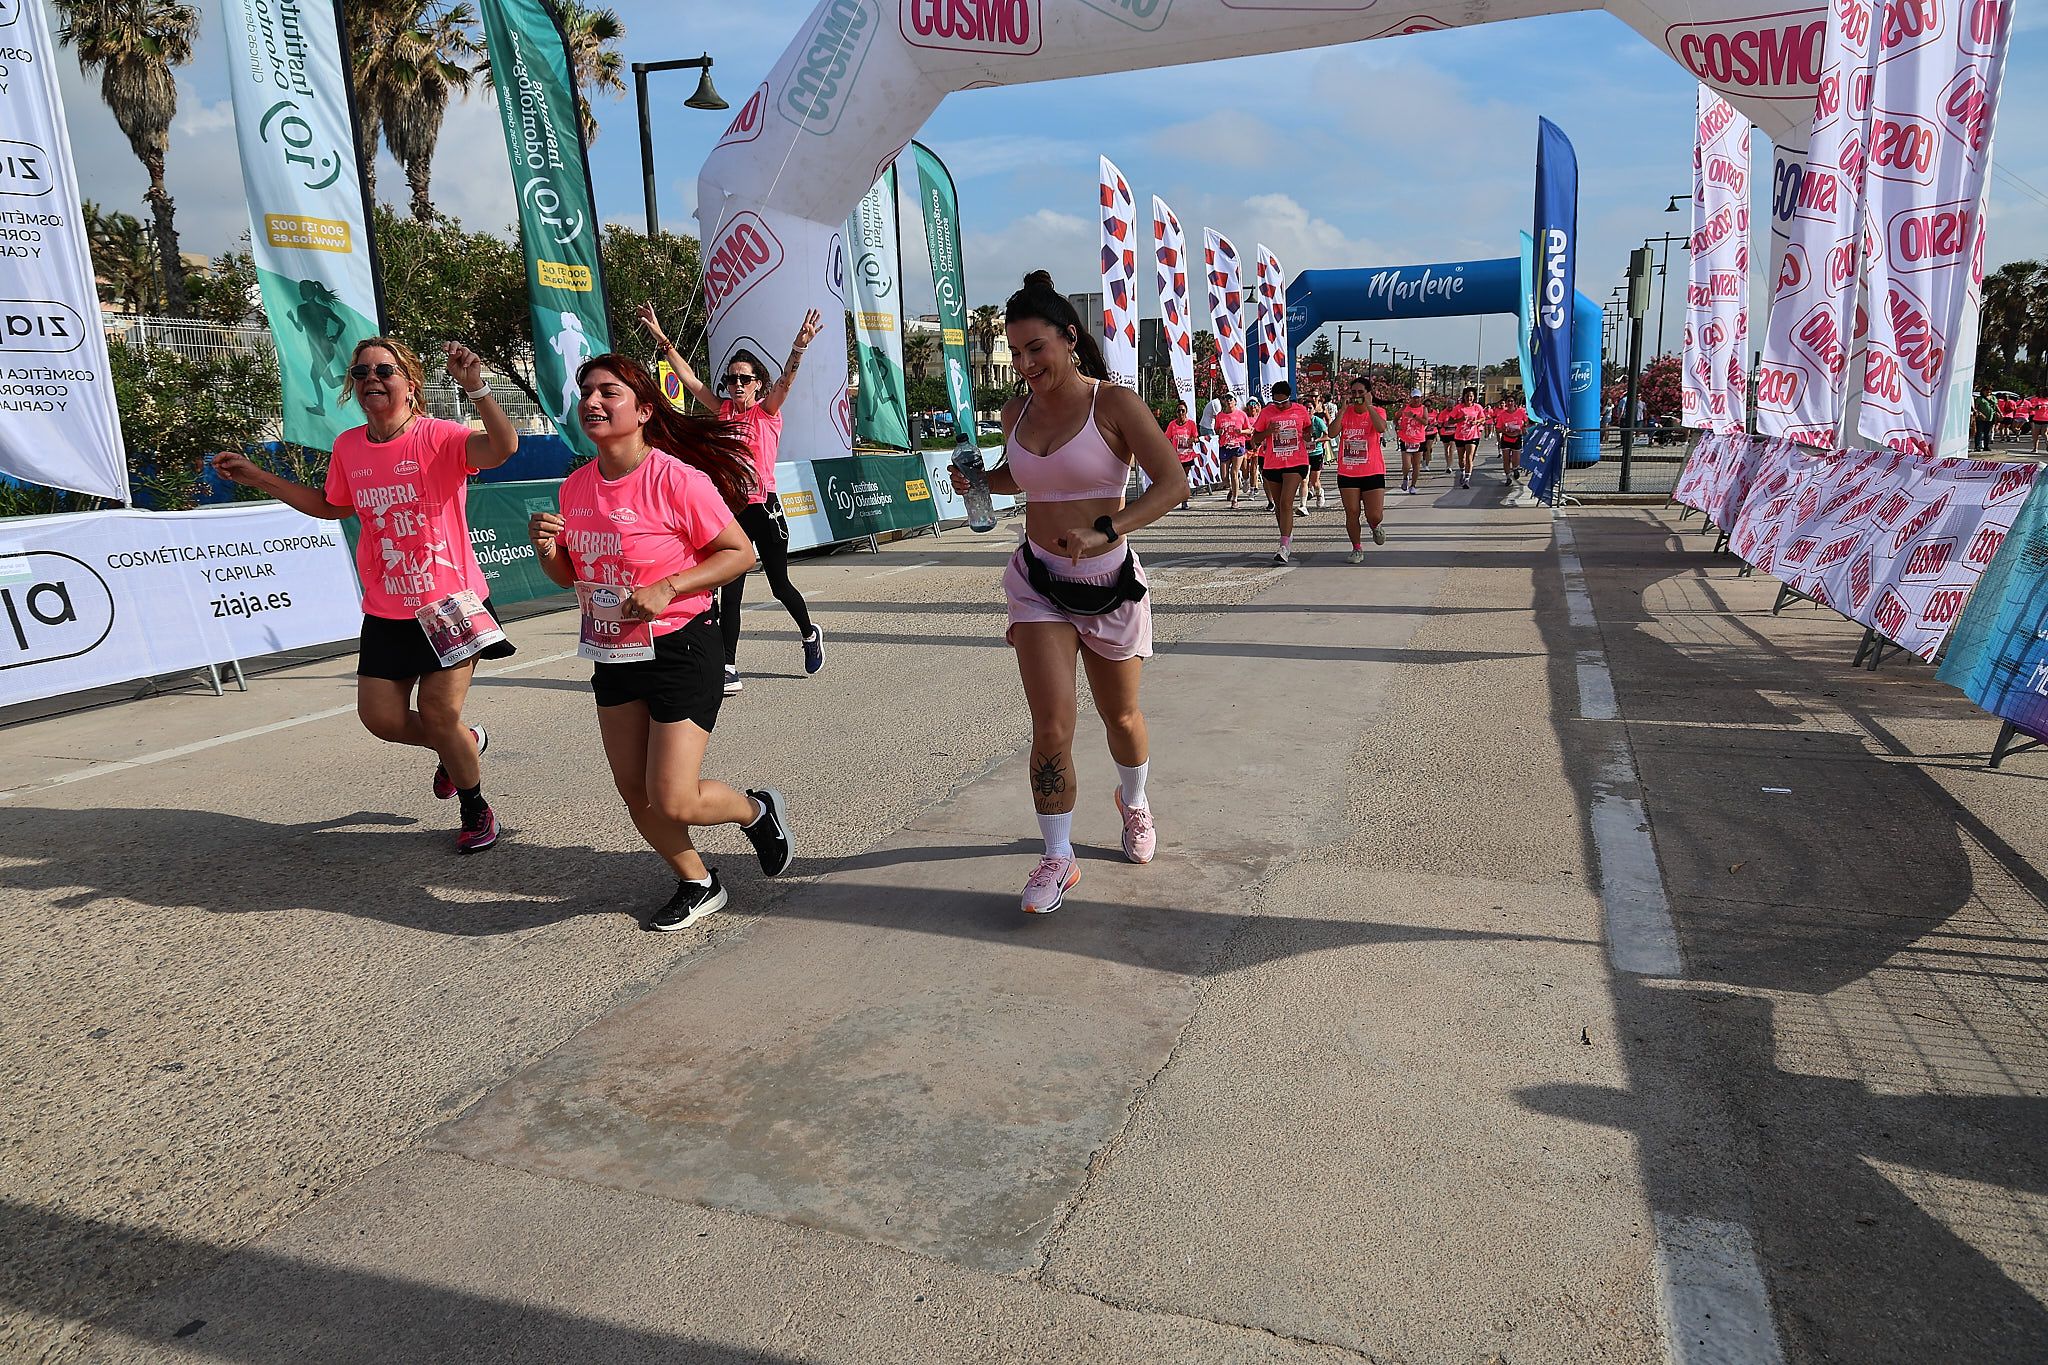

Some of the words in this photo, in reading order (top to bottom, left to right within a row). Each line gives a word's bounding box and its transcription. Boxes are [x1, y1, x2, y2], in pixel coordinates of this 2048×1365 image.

[787, 0, 868, 120] COSMO
[1367, 267, 1464, 312] Marlene
[356, 483, 419, 508] CARRERA
[1894, 492, 1949, 550] COSMO
[107, 546, 208, 569] COSMÉTICA
[207, 542, 262, 559] FACIAL,
[262, 534, 336, 554] CORPORAL
[566, 530, 624, 556] CARRERA
[1815, 534, 1860, 567] COSMO
[1905, 542, 1953, 575] COSMO
[201, 569, 211, 583] Y
[215, 563, 276, 582] CAPILAR
[385, 572, 436, 595] MUJER
[210, 591, 292, 618] ziaja.es
[1874, 591, 1907, 641] COSMO
[449, 617, 473, 637] 016
[594, 619, 621, 635] 016
[447, 648, 469, 662] OYSHO
